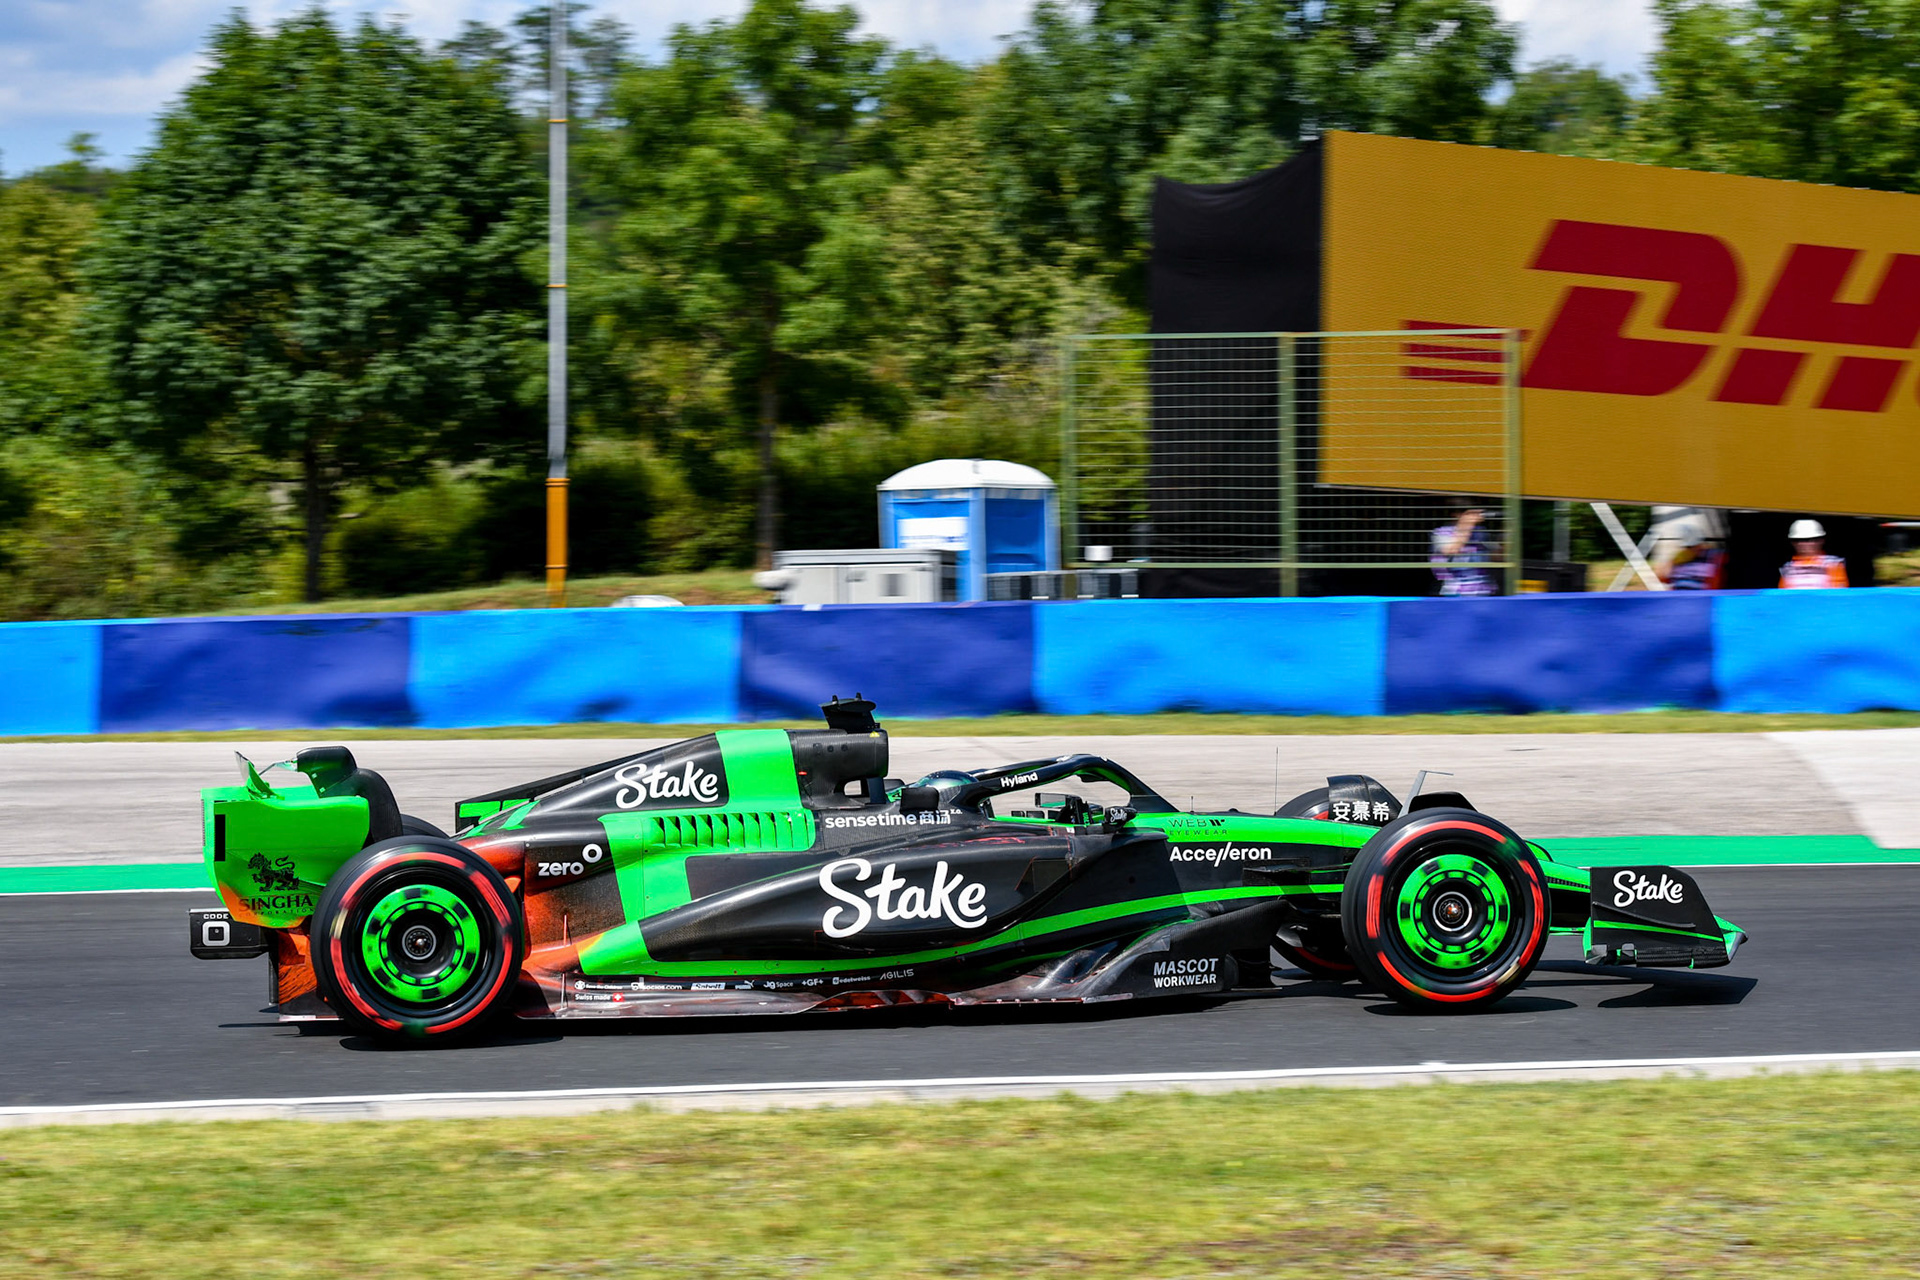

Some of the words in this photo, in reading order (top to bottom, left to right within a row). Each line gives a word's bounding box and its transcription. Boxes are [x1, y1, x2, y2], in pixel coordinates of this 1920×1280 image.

[1517, 219, 1920, 414] DH
[614, 761, 719, 809] Stake
[1001, 772, 1038, 788] Hyland
[1333, 801, 1390, 822] 安慕希
[825, 812, 917, 829] sensetime
[1168, 819, 1207, 828] WEB
[1613, 870, 1684, 907] Stake
[239, 895, 313, 912] SINGHA
[819, 858, 988, 939] Stake
[880, 969, 915, 980] AGILIS
[1153, 958, 1219, 976] MASCOT
[1154, 974, 1217, 988] WORKWEAR
[575, 993, 593, 1001] Swiss
[594, 992, 611, 1000] made
